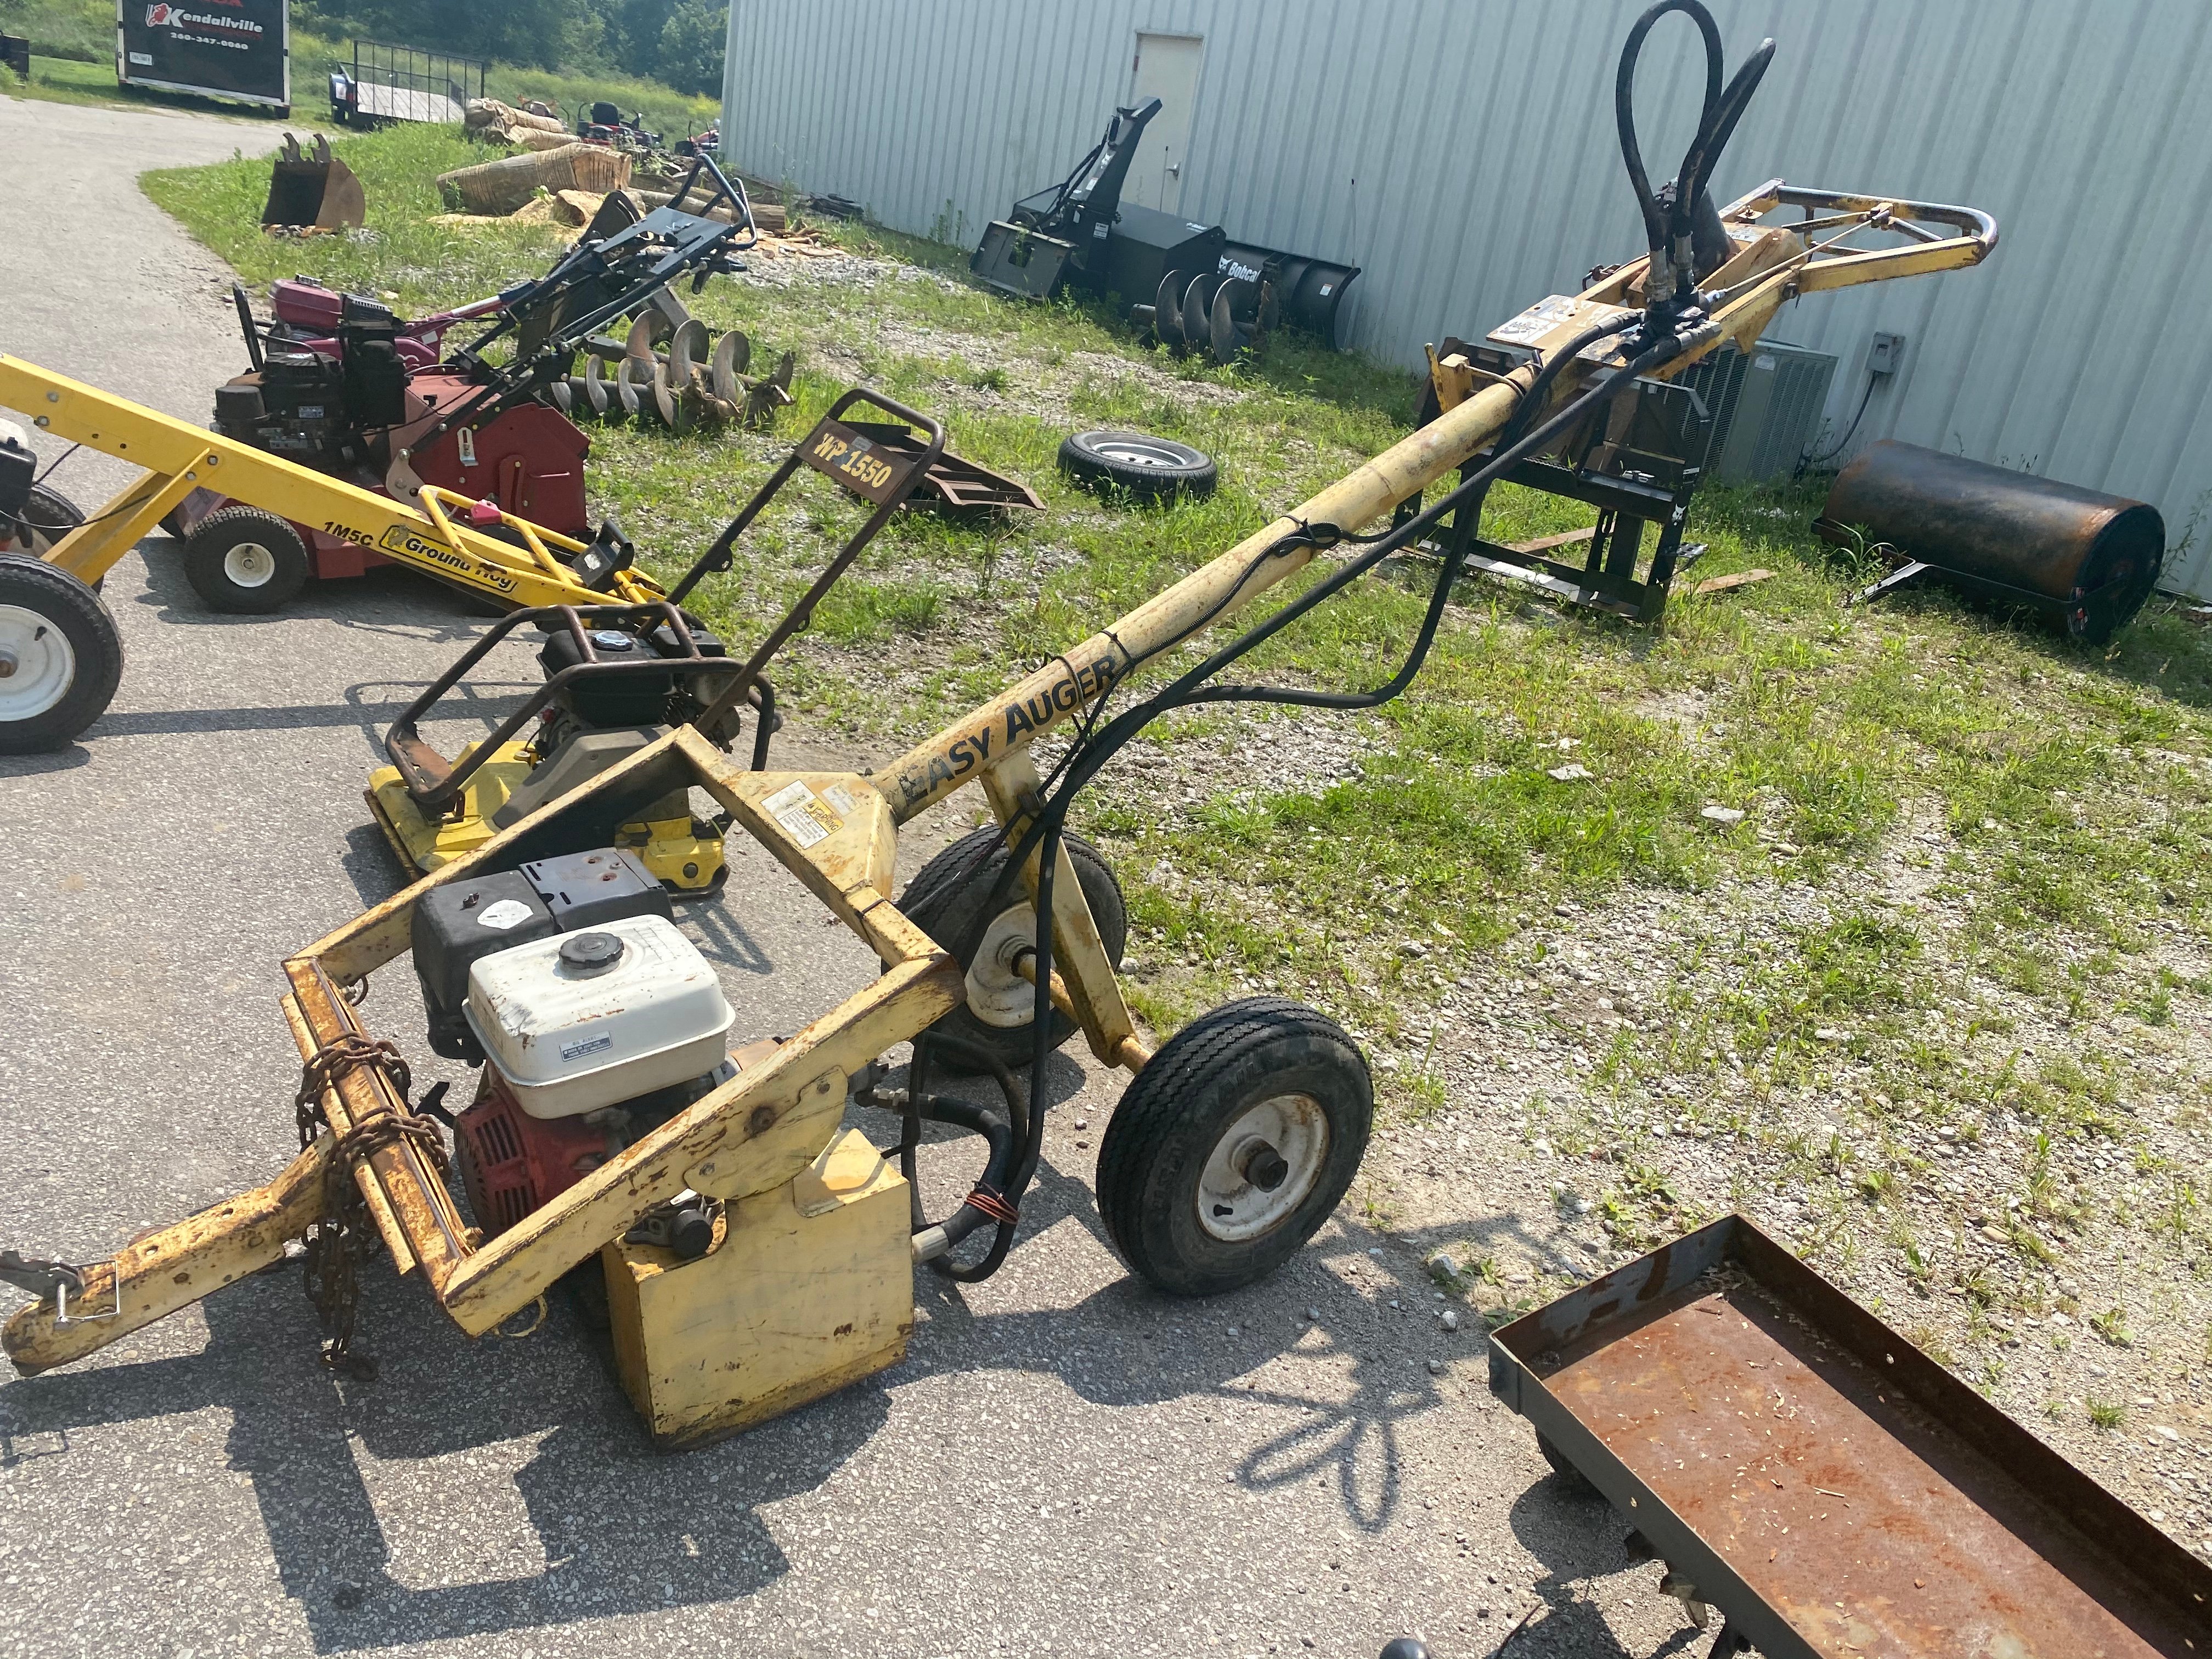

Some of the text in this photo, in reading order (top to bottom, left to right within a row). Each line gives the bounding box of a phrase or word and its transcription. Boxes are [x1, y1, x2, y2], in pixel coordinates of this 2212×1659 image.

[165, 8, 263, 33] Kendallville
[813, 433, 892, 488] WP 1550
[324, 521, 374, 547] 1M5C
[1005, 654, 1116, 746] AUGER
